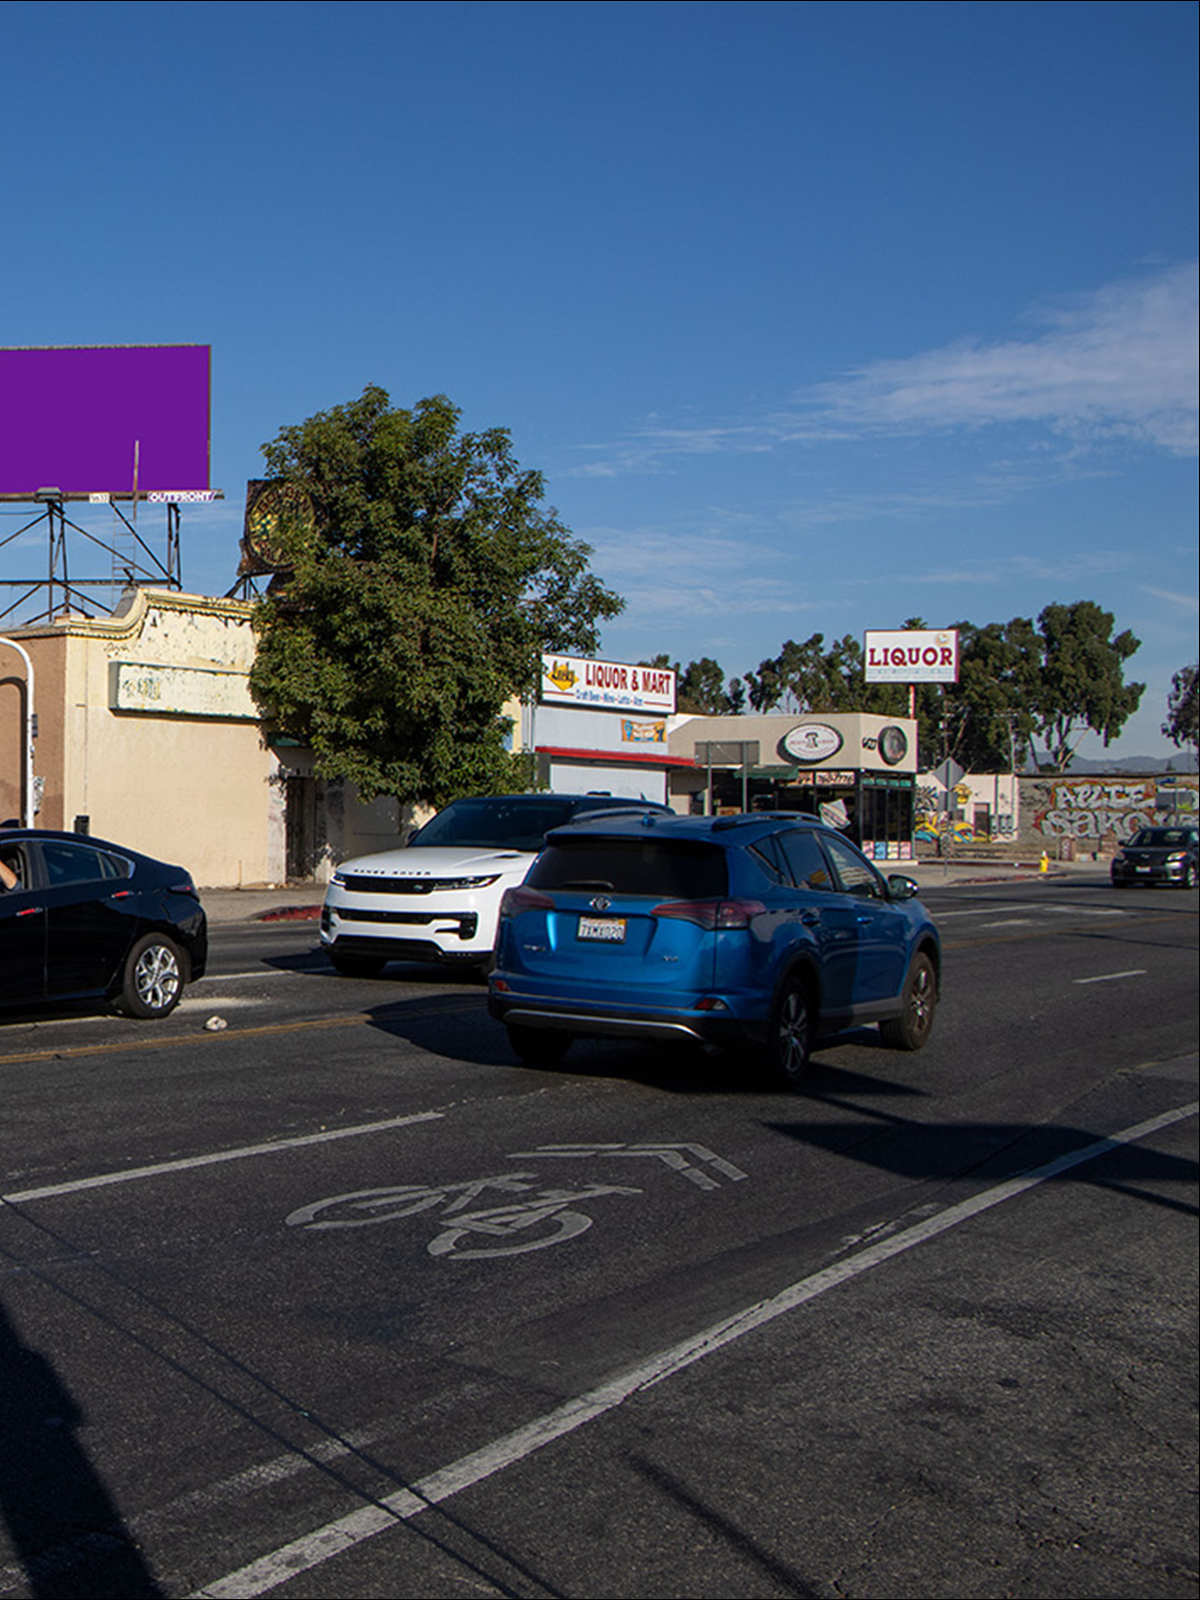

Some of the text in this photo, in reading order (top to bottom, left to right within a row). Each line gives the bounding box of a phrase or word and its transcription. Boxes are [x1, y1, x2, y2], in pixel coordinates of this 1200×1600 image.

[868, 646, 953, 667] LIQUOR
[585, 663, 672, 695] LIQUOR & MART
